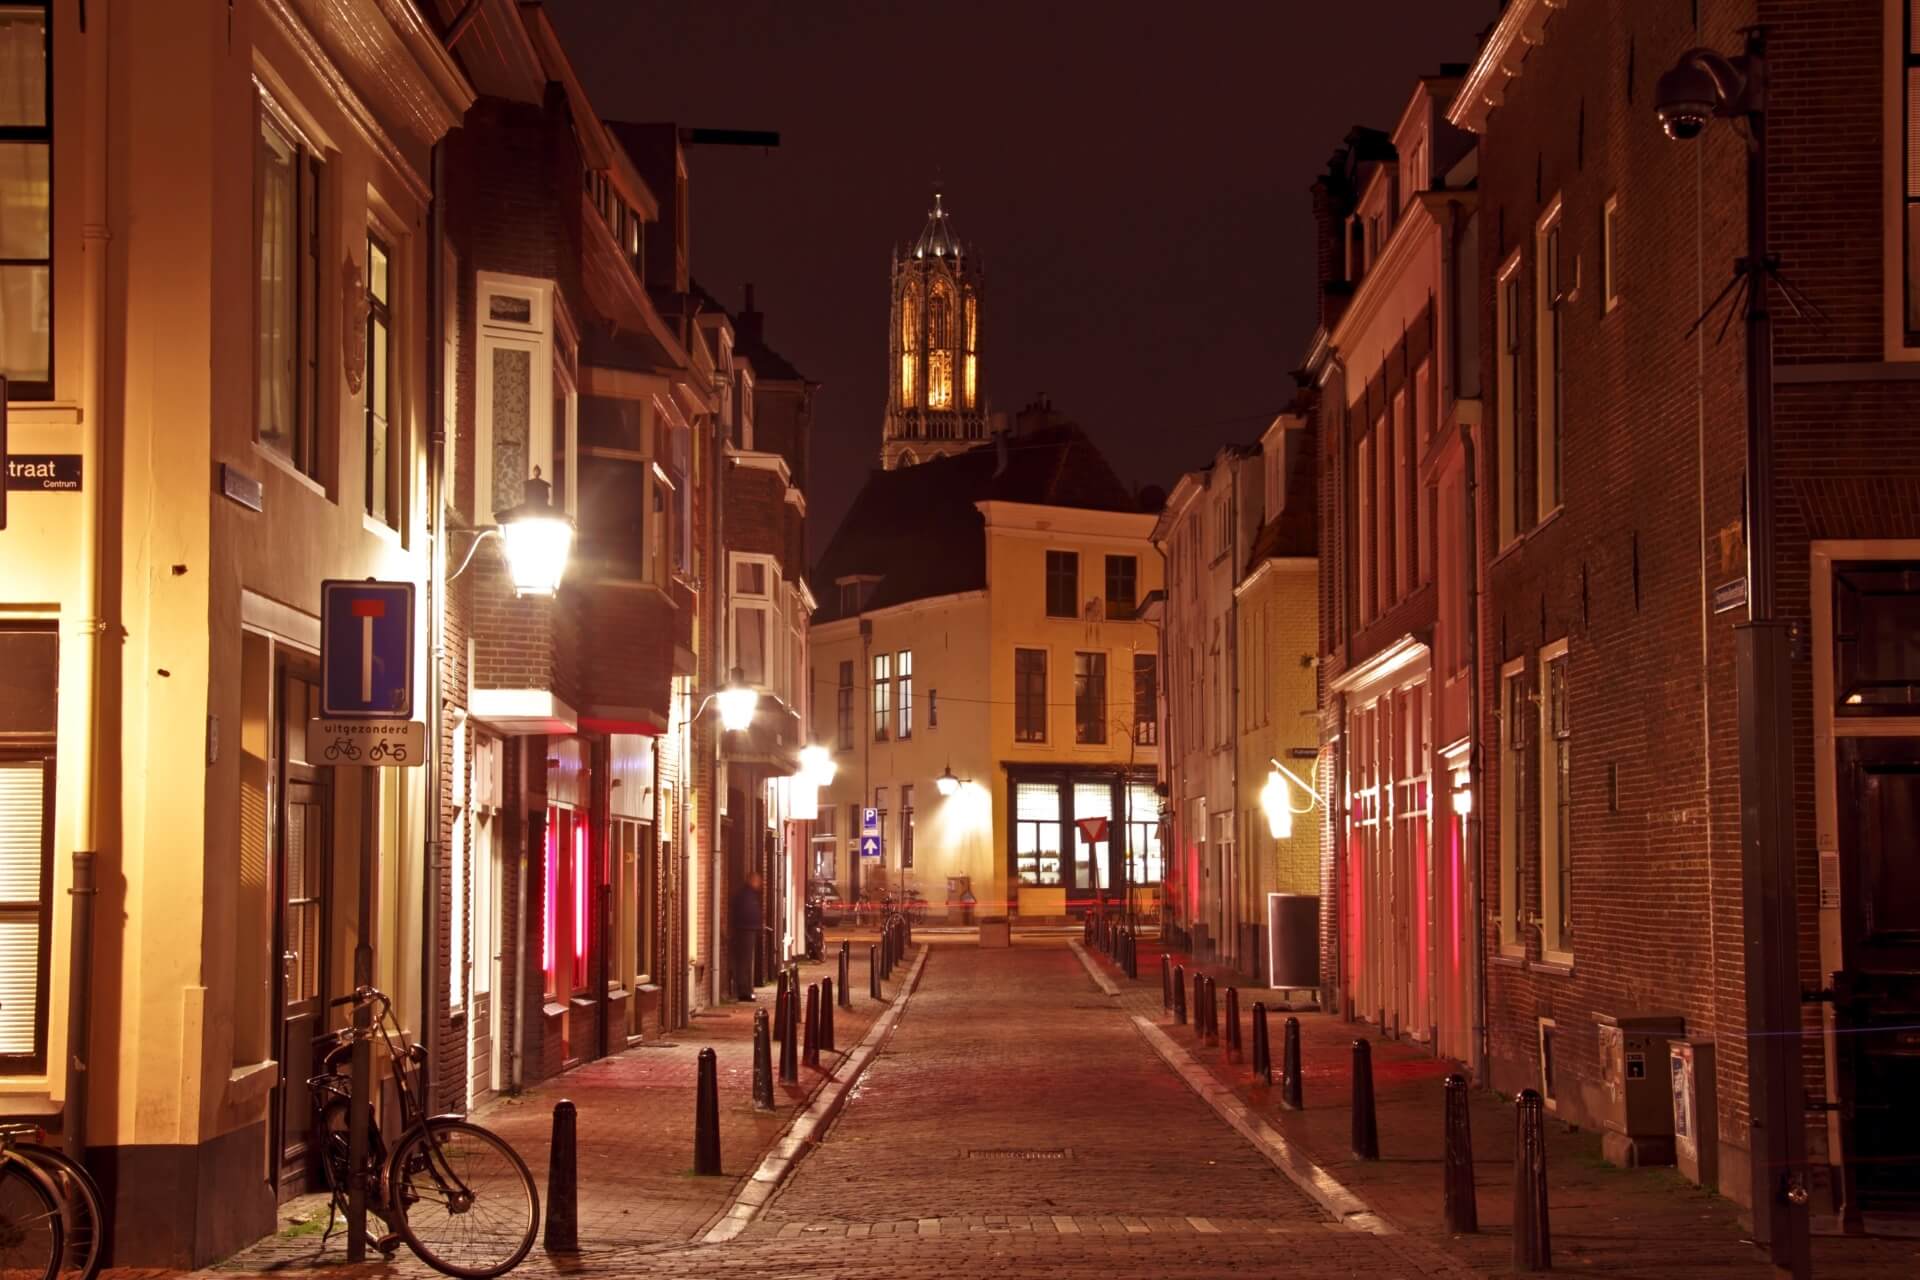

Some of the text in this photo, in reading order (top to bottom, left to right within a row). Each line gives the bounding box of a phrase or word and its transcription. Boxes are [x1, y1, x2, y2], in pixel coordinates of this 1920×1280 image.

[6, 460, 56, 477] traat
[43, 480, 77, 488] Centrum
[324, 724, 409, 735] uitgezonderd
[866, 810, 875, 822] P
